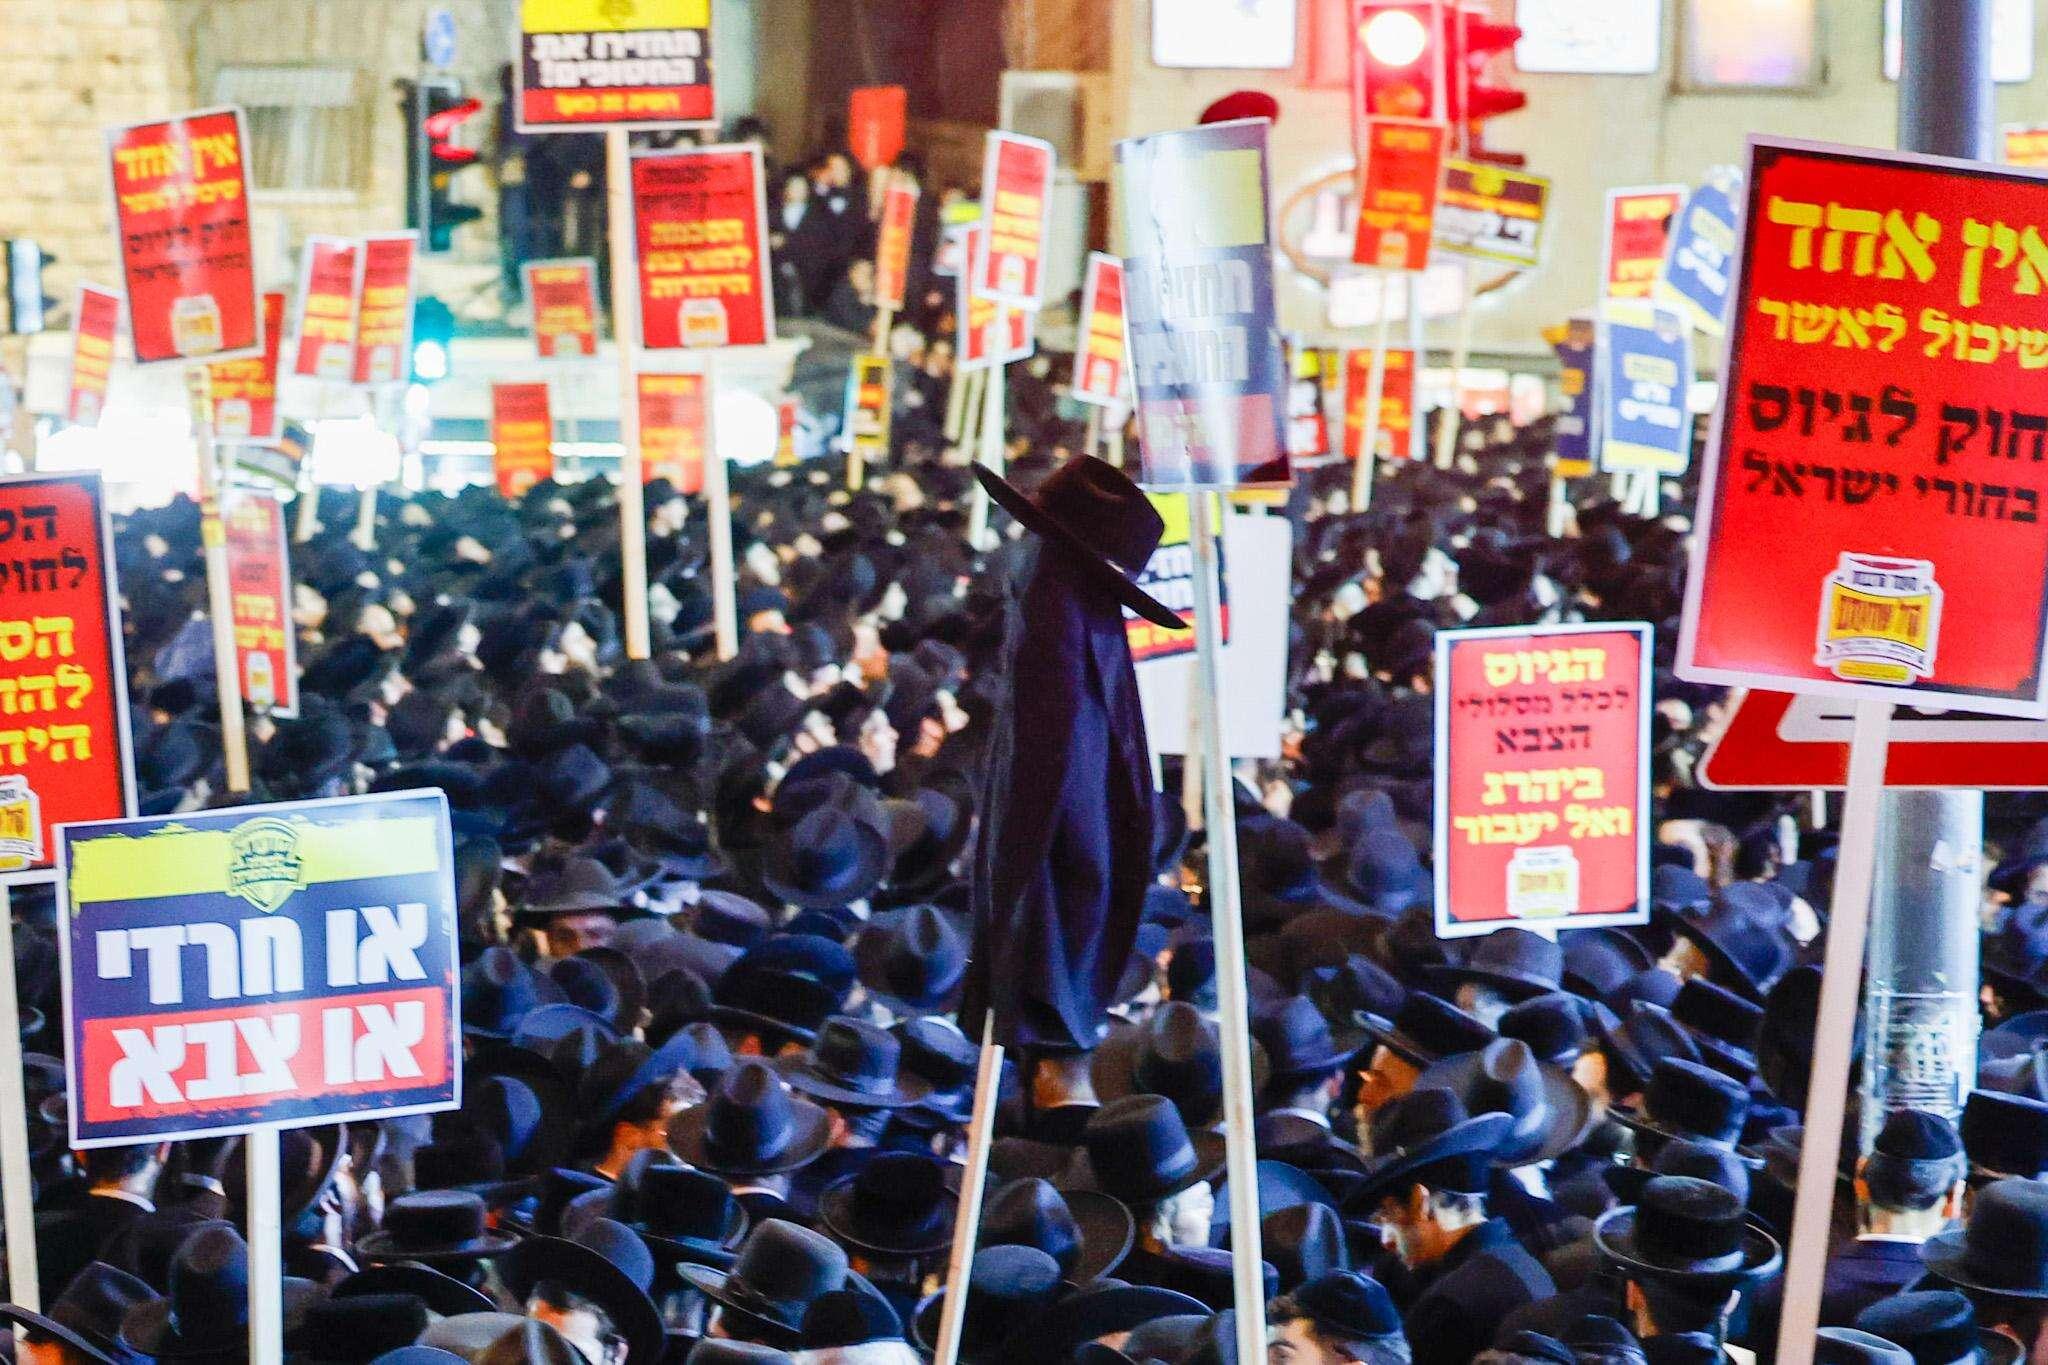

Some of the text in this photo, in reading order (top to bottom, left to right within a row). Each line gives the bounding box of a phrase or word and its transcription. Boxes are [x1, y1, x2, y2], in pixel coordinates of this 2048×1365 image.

[1767, 195, 1943, 283] אחד
[1758, 296, 1908, 354] לאשר
[1749, 382, 1917, 446] לגיוס
[1743, 448, 2038, 523] בחורי ישראל
[0, 546, 88, 593] להו
[1482, 647, 1606, 688] הגיוס
[1496, 724, 1591, 754] הצבא
[1481, 766, 1606, 806] ביהרג
[1453, 803, 1633, 846] ואל יעבור
[95, 902, 429, 1005] או חרדי
[109, 1000, 425, 1108] או צבא
